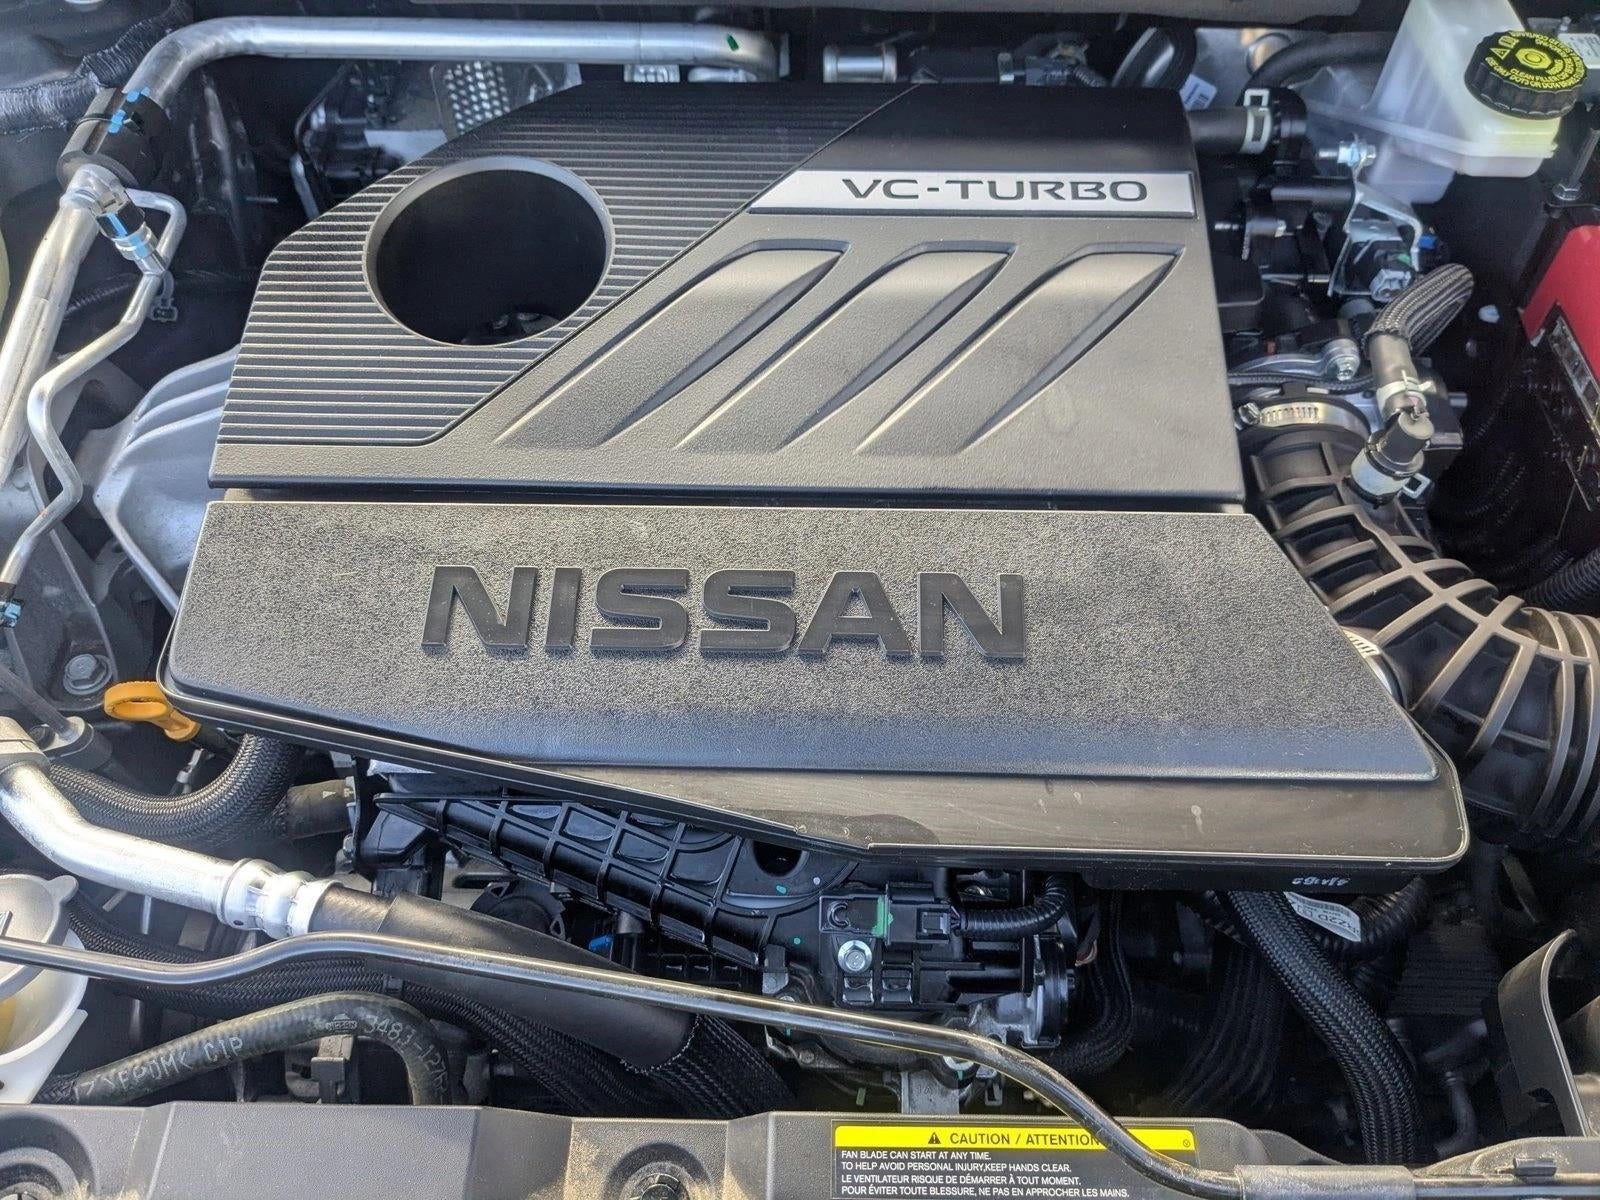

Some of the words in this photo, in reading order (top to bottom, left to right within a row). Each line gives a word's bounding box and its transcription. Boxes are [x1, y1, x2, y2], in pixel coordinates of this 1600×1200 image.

[1510, 68, 1535, 80] CLEAN
[842, 179, 1147, 201] VC-TURBO
[421, 564, 1024, 662] NISSAN
[950, 1133, 1009, 1144] CAUTION
[1015, 1134, 1021, 1144] /
[1026, 1134, 1099, 1145] ATTENTION
[841, 1151, 858, 1159] FAN
[860, 1151, 888, 1159] BLADE
[890, 1151, 908, 1159] CAN
[910, 1151, 937, 1159] START
[938, 1151, 948, 1159] AT
[970, 1152, 991, 1160] TIME.
[841, 1162, 853, 1170] TO
[855, 1162, 877, 1170] HELP
[879, 1162, 905, 1170] AVOID
[907, 1163, 954, 1171] PERSONAL
[1009, 1164, 1039, 1172] HANDS
[1041, 1164, 1071, 1172] CLEAR.
[854, 1175, 909, 1183] VENTILATEUR
[911, 1175, 943, 1184] RISQUE
[946, 1176, 957, 1184] DE
[960, 1173, 1007, 1184] DÉMARRER
[1009, 1174, 1015, 1184] À
[1041, 1177, 1081, 1185] MOMENT.
[841, 1186, 866, 1194] POUR
[868, 1184, 897, 1195] ÉVITER
[899, 1187, 927, 1195] TOUTE
[929, 1187, 977, 1197] BLESSURE,
[1026, 1188, 1080, 1196] APPROCHER
[1082, 1189, 1098, 1197] LES
[1100, 1189, 1129, 1197] MAINS.
